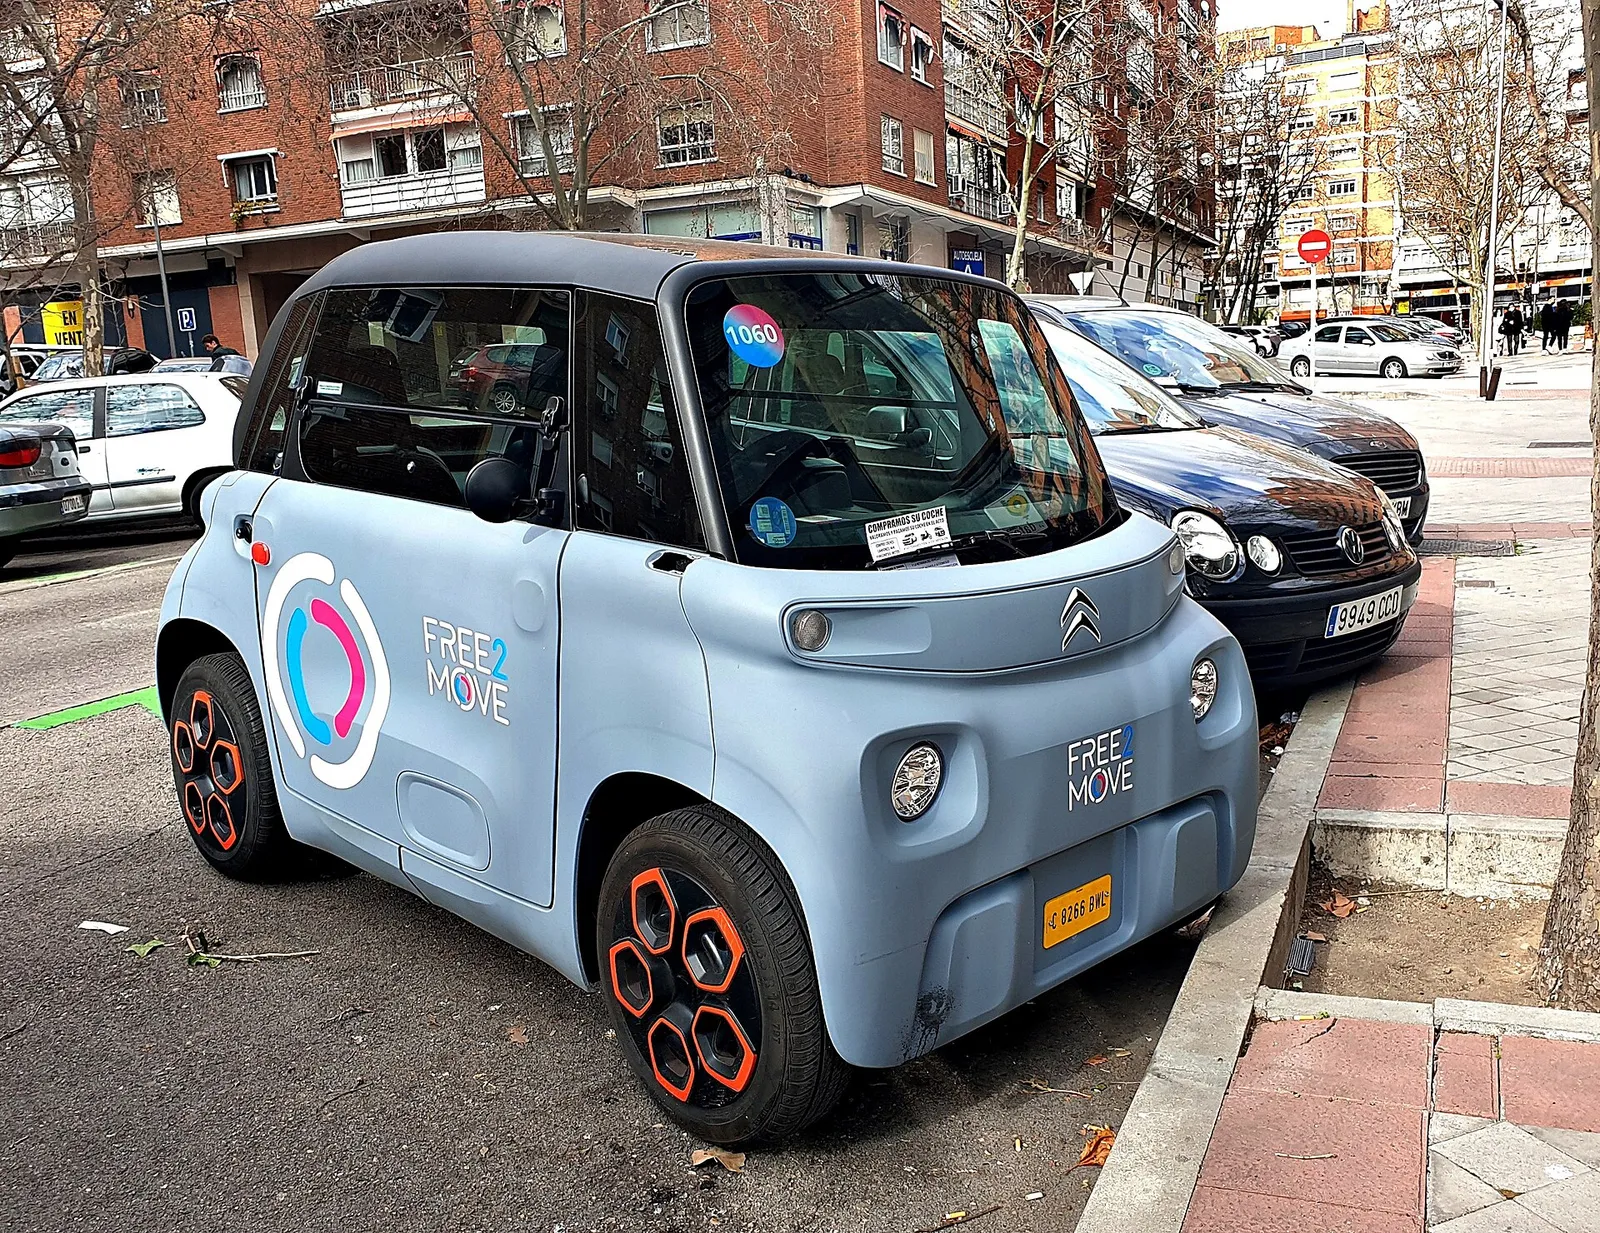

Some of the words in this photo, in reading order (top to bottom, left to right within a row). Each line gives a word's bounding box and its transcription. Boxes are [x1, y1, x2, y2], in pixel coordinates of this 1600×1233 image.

[62, 310, 77, 326] EN
[182, 311, 190, 328] P
[726, 323, 778, 346] 1060
[54, 331, 83, 345] VENT
[868, 515, 911, 534] COMPRAMOS
[911, 512, 921, 522] SU
[921, 508, 944, 521] COCHE
[1338, 600, 1376, 631] 9949
[1378, 591, 1399, 619] CCD
[422, 616, 509, 681] FREE2
[426, 658, 510, 726] MOVE
[1067, 724, 1134, 776] FREE2
[1068, 758, 1134, 811] MOVE
[1061, 899, 1086, 926] 8266
[1089, 891, 1107, 913] BWL
